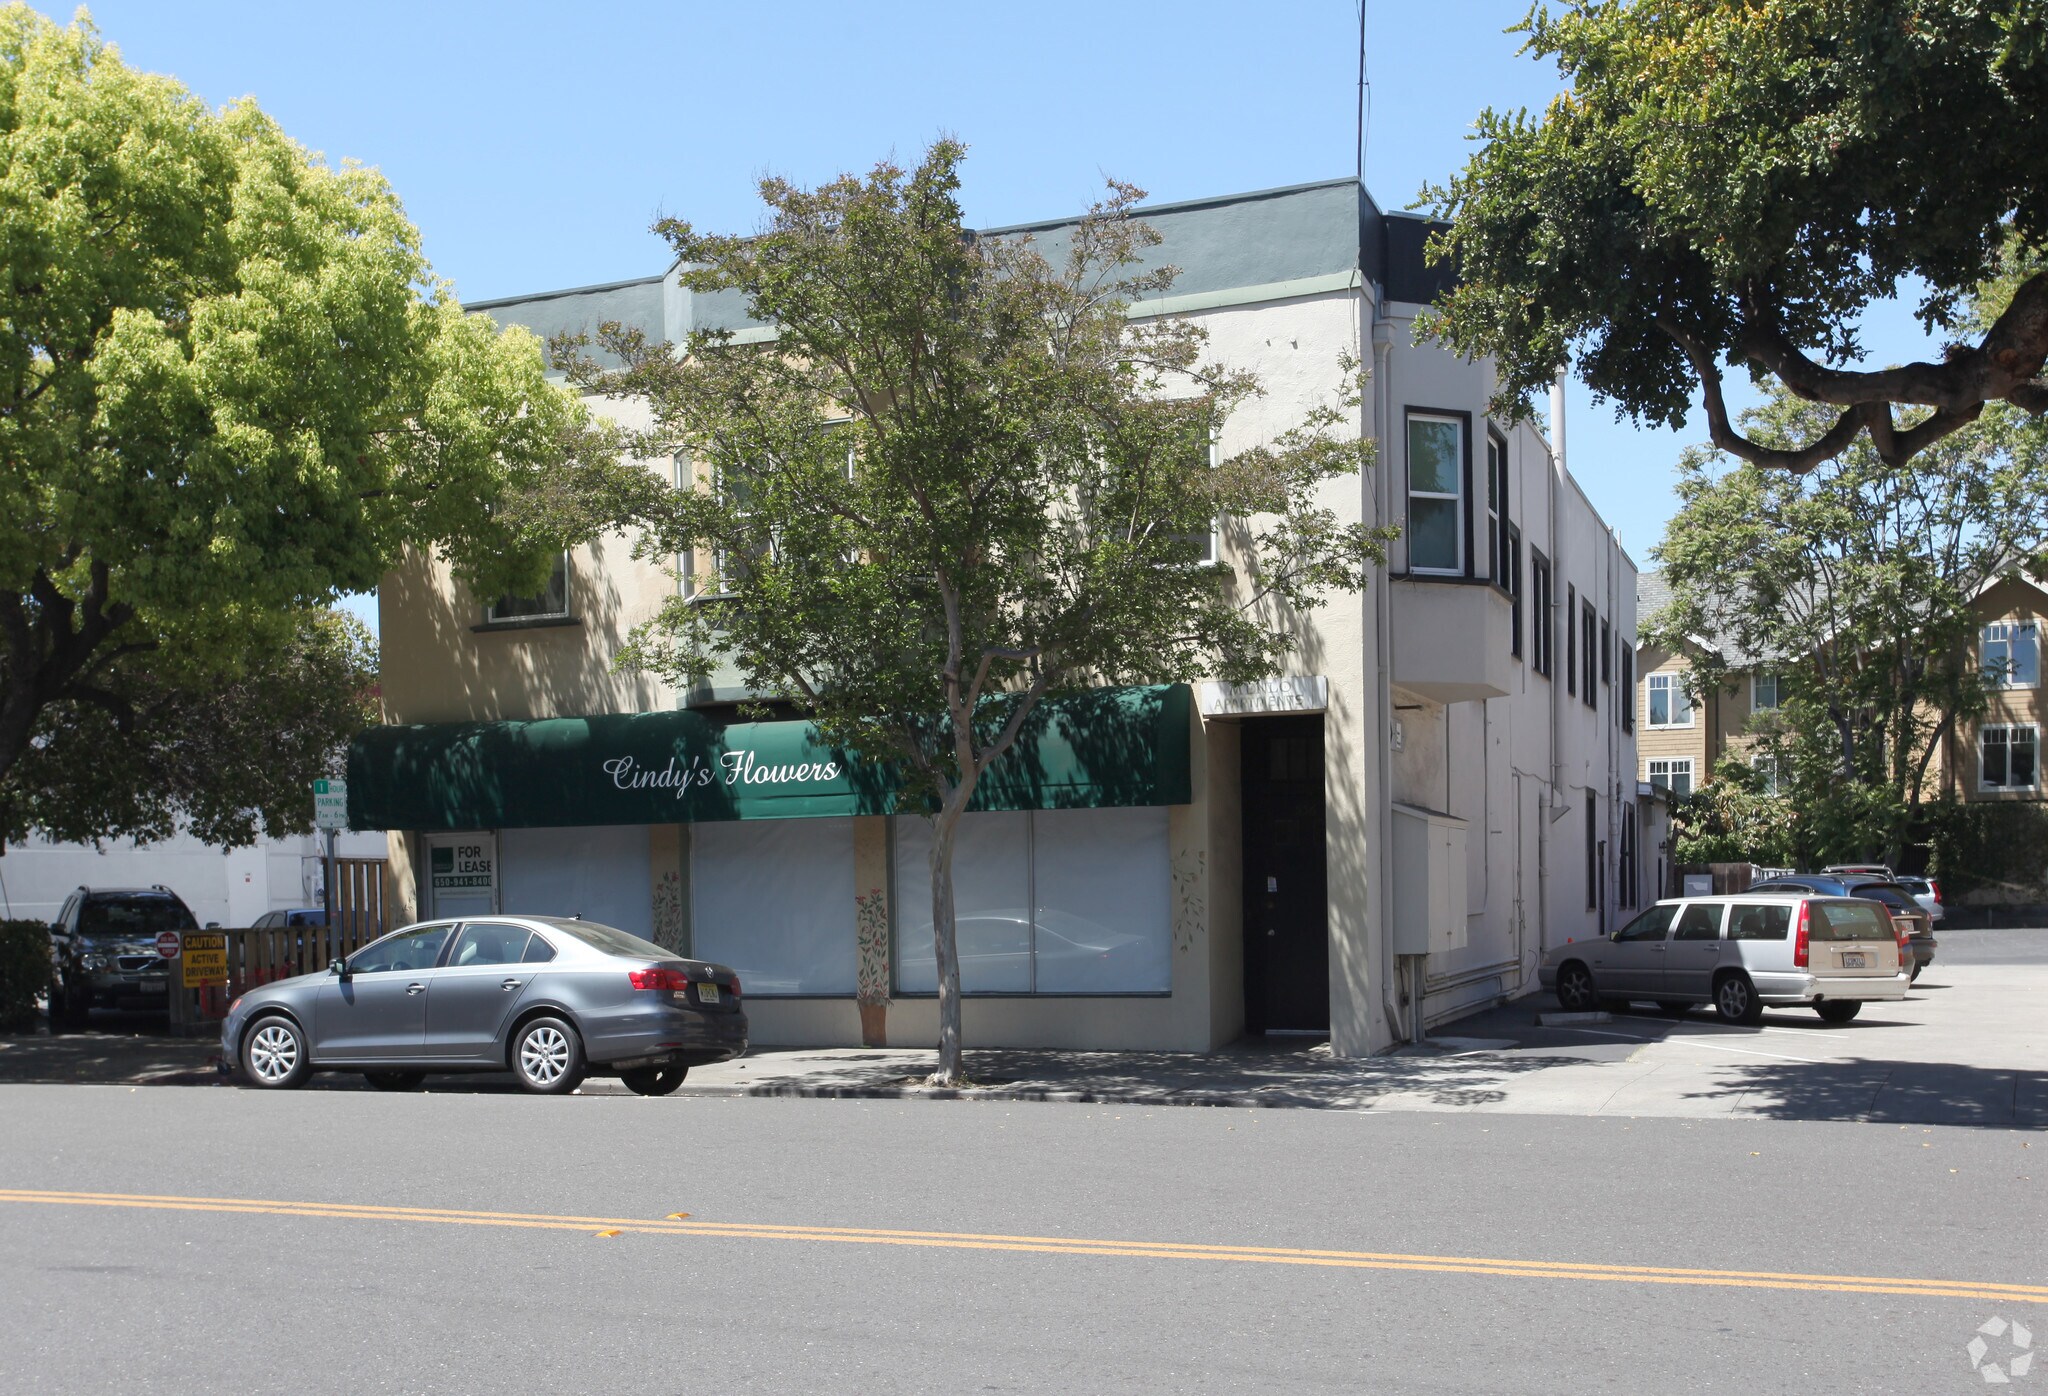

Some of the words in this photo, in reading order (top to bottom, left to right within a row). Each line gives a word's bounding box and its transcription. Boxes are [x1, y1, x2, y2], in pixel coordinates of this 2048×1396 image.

[1214, 695, 1304, 711] APARTMENTS
[603, 755, 715, 799] Cindy's
[720, 750, 842, 785] Flowers
[317, 798, 344, 807] PARKING
[458, 846, 481, 858] FOR
[458, 860, 492, 873] LEASE
[184, 936, 224, 949] CAUTION
[191, 954, 219, 964] ACTIVE
[185, 966, 225, 977] DRIVEWAY
